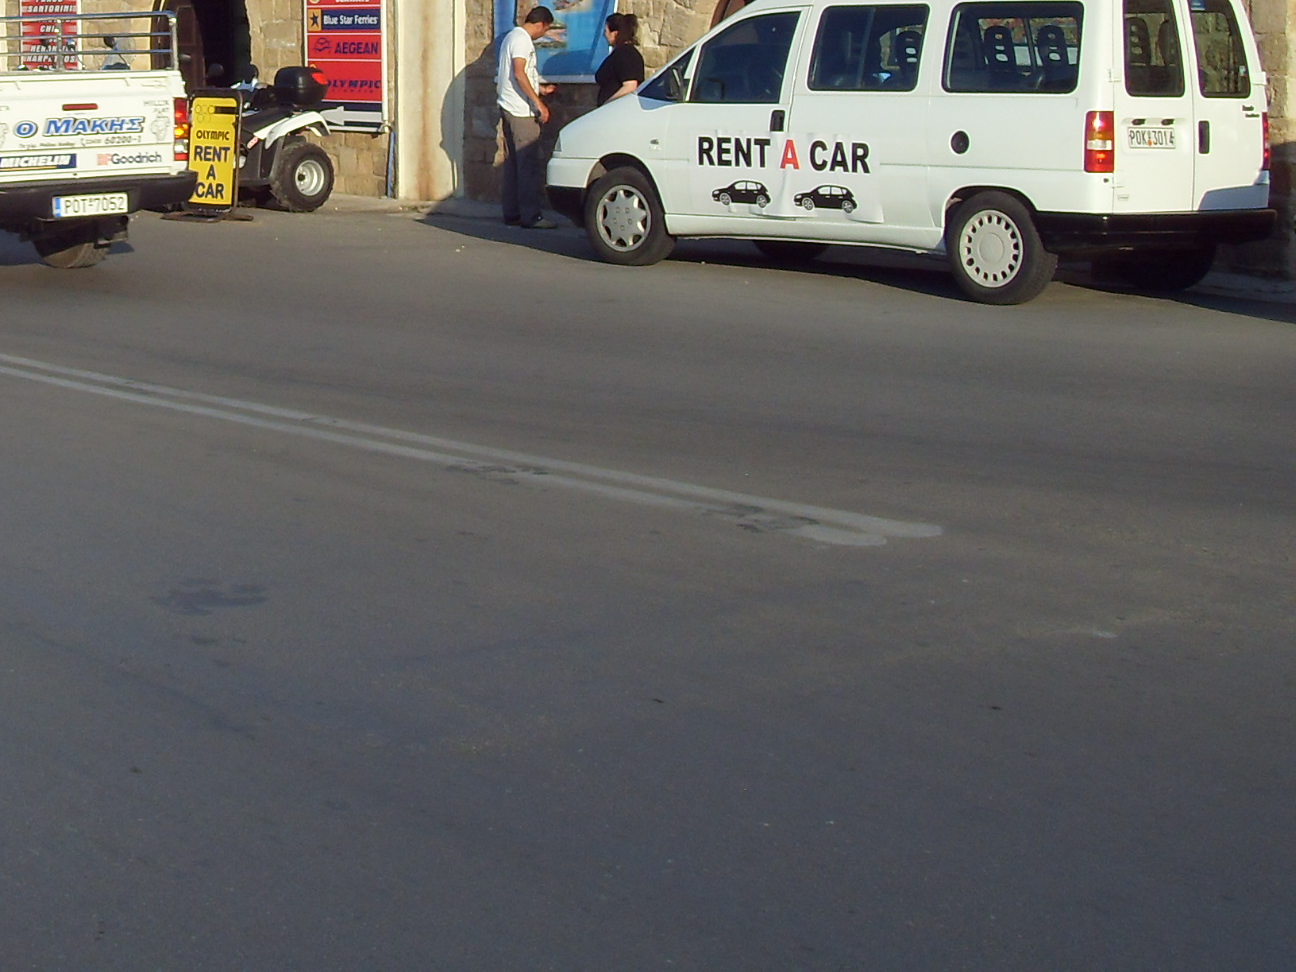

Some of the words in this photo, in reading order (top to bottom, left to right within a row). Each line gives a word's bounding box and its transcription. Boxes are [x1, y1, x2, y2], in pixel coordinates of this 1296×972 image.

[27, 4, 73, 13] SANTORINI
[323, 14, 338, 25] Blue
[339, 13, 353, 25] Star
[354, 13, 379, 25] Ferries
[334, 41, 379, 55] AEGEAN
[43, 116, 145, 137] ΜΑΚΗΣ
[195, 129, 230, 141] OLYMPIC
[0, 154, 72, 169] MICHELIN
[193, 145, 230, 163] RENT
[698, 136, 771, 168] RENT
[779, 139, 800, 170] A
[809, 140, 871, 174] CAR
[206, 164, 216, 181] A
[194, 182, 225, 199] CAR
